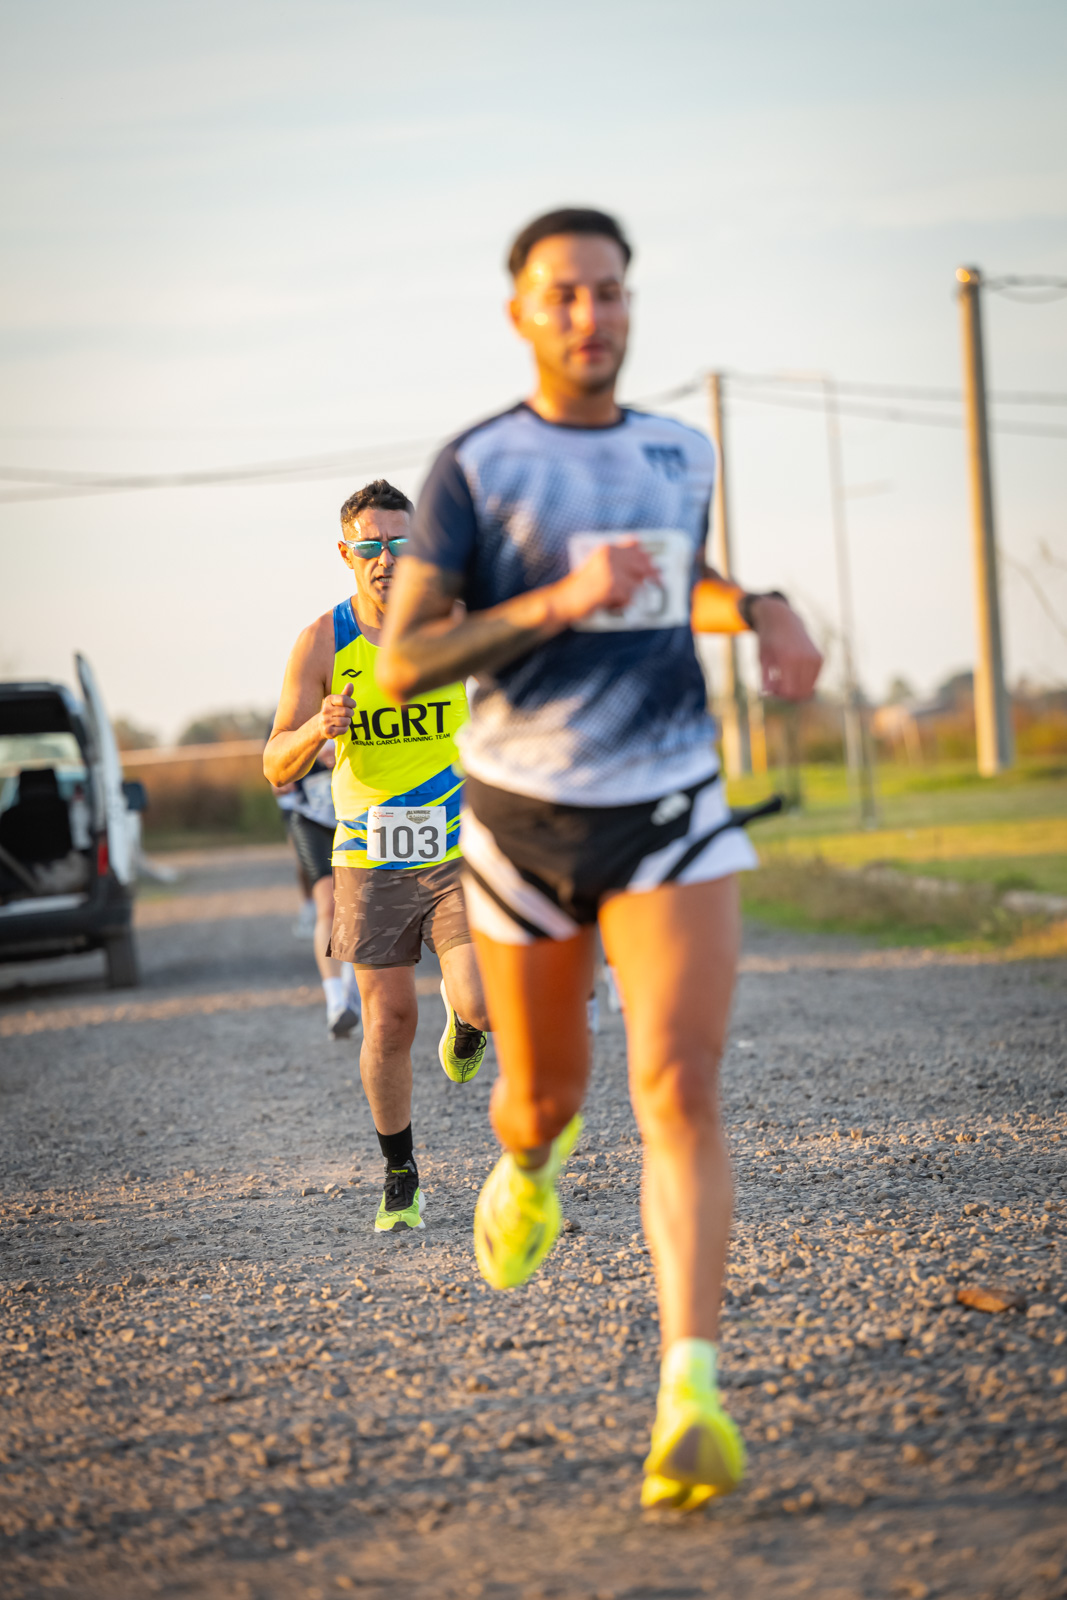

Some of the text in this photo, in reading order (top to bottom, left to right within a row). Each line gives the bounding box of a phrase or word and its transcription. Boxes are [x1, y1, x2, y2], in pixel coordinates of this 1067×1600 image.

[350, 701, 451, 741] HGRT
[403, 735, 433, 743] RUNNING
[372, 825, 440, 859] 103
